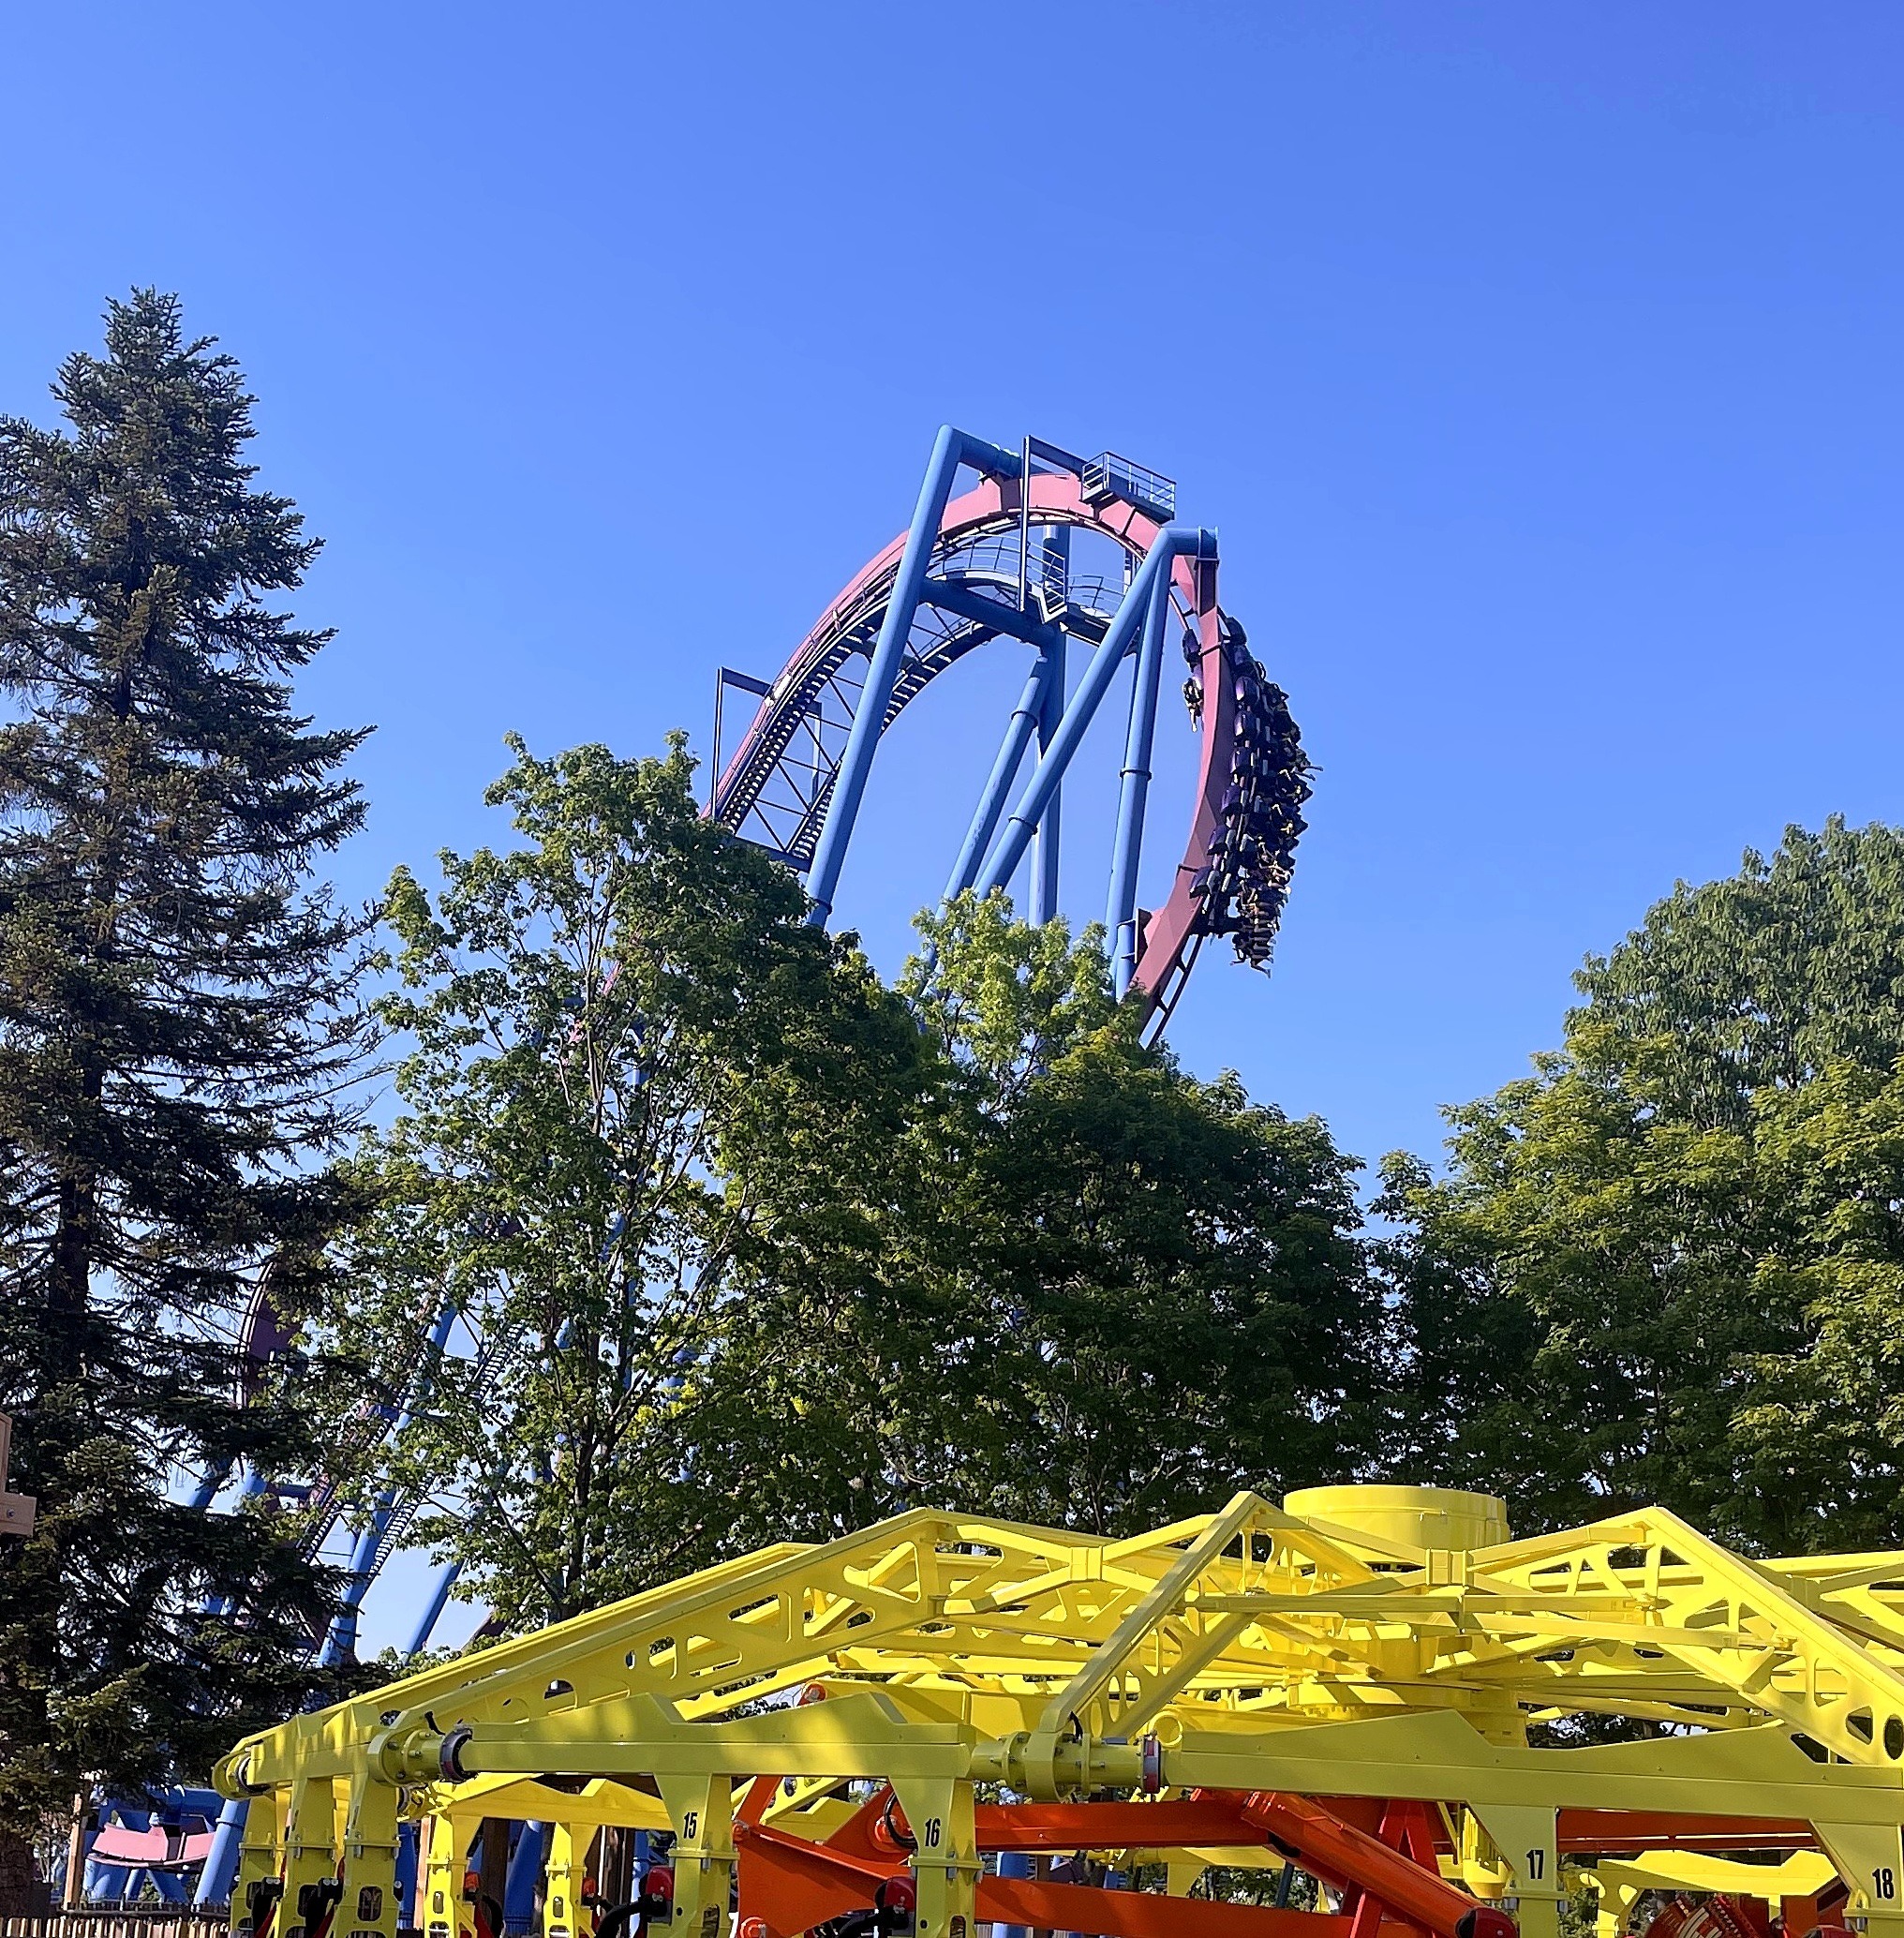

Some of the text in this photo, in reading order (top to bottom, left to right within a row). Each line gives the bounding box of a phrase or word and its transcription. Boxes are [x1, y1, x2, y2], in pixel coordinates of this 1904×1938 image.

[683, 1811, 697, 1839] 15
[925, 1818, 941, 1847] 16
[1525, 1850, 1544, 1879] 17
[1872, 1869, 1894, 1899] 18
